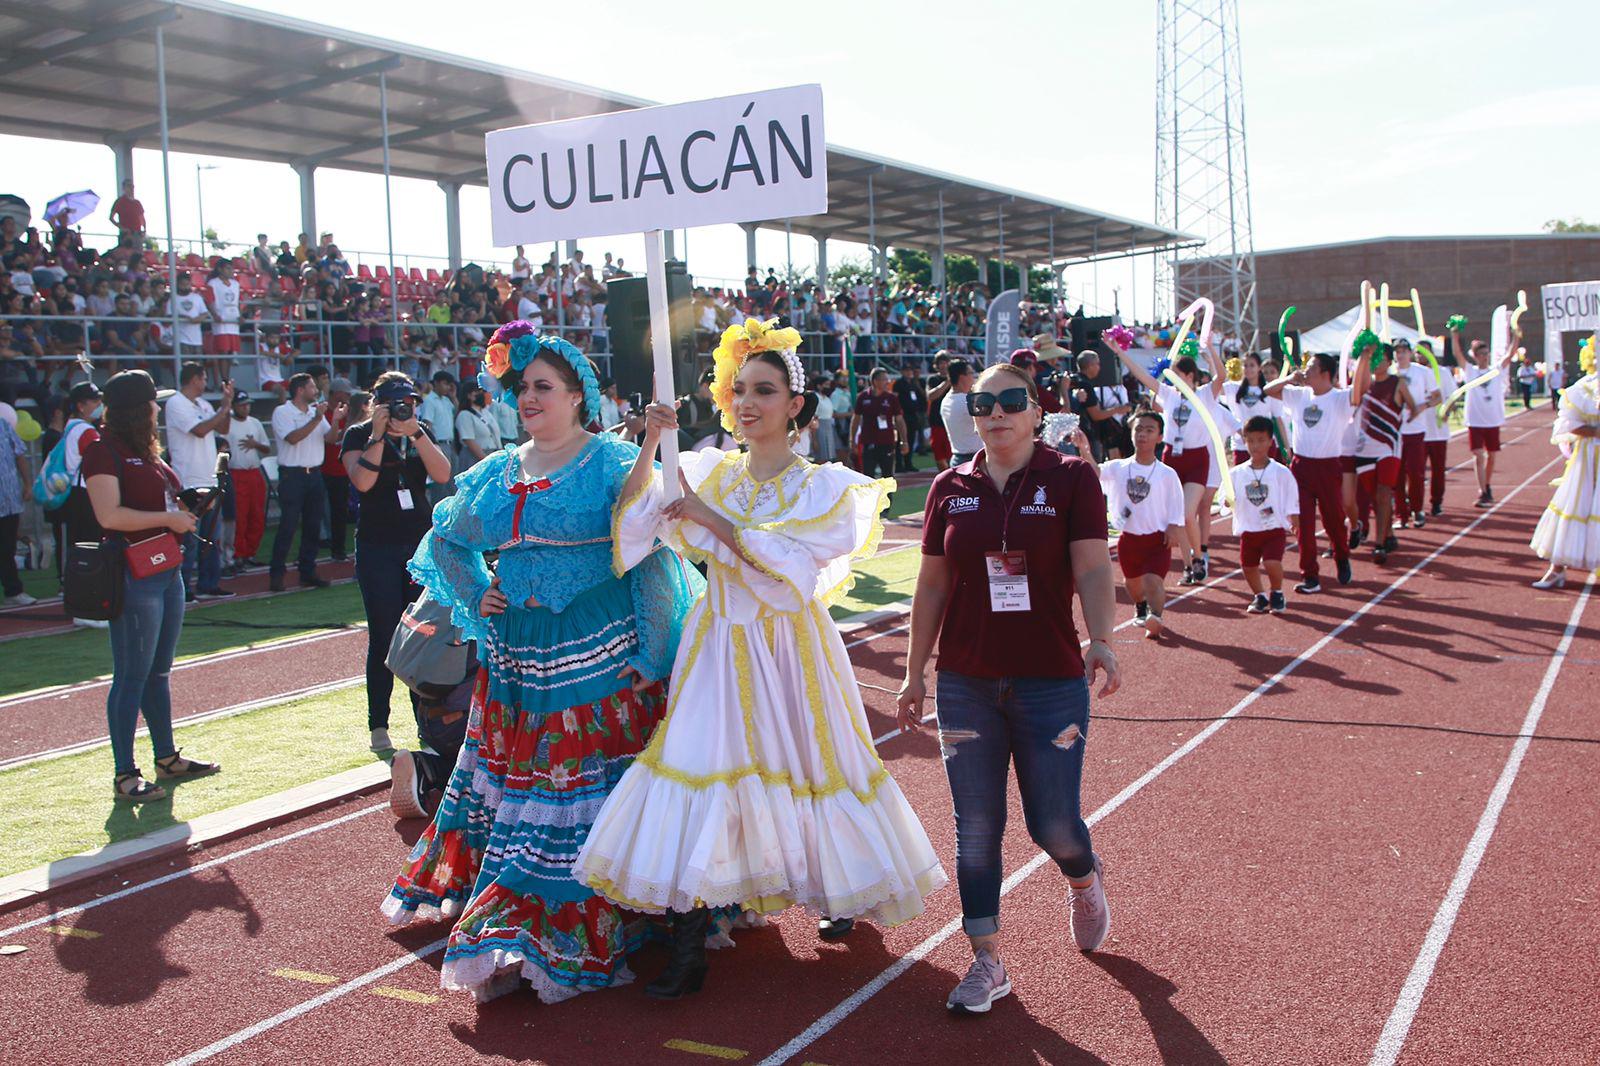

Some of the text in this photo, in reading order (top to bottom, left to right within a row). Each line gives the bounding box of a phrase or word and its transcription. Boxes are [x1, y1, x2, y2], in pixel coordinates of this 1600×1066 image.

[503, 101, 813, 214] CULIACÁN
[997, 311, 1010, 348] ISDE
[1020, 505, 1056, 514] SINALOA
